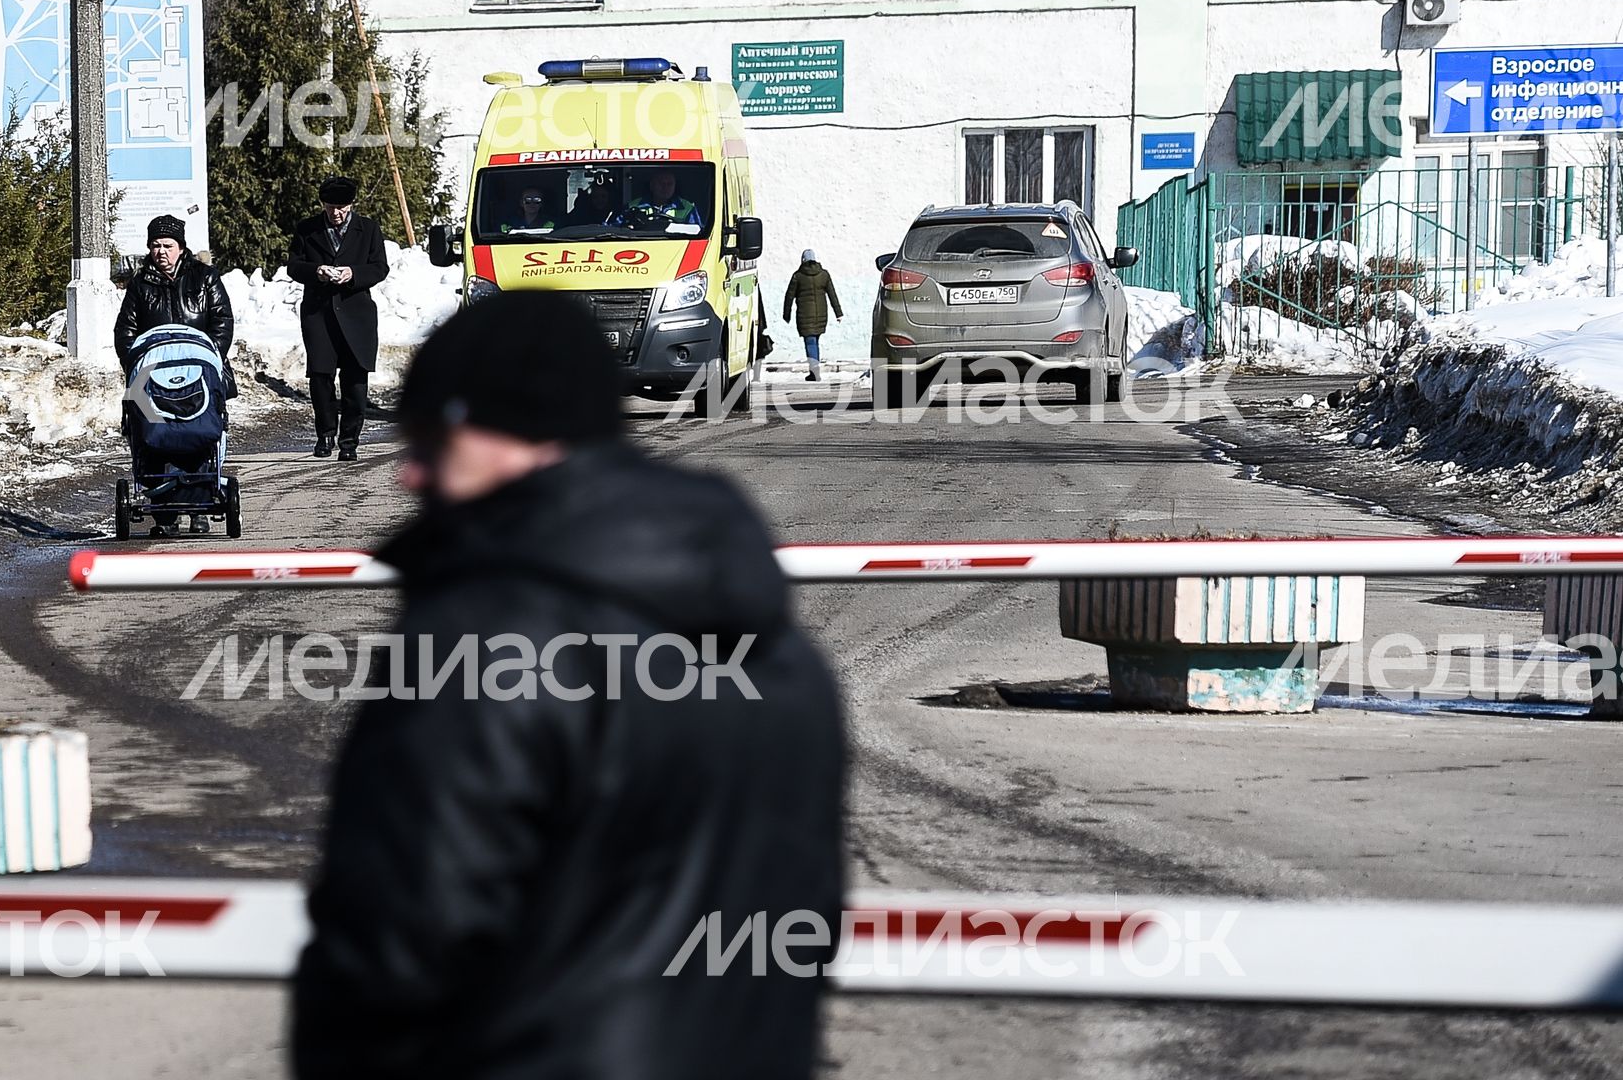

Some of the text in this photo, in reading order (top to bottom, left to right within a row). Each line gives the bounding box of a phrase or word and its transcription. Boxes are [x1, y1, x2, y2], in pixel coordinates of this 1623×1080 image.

[738, 45, 838, 57] Аптечный пункт
[1492, 56, 1595, 78] Взрослое
[738, 70, 838, 83] в хирургическом
[765, 85, 812, 97] корпусе
[1491, 104, 1603, 123] отделение
[519, 149, 669, 163] РЕАНИМАЦИЯ
[998, 287, 1014, 295] 750
